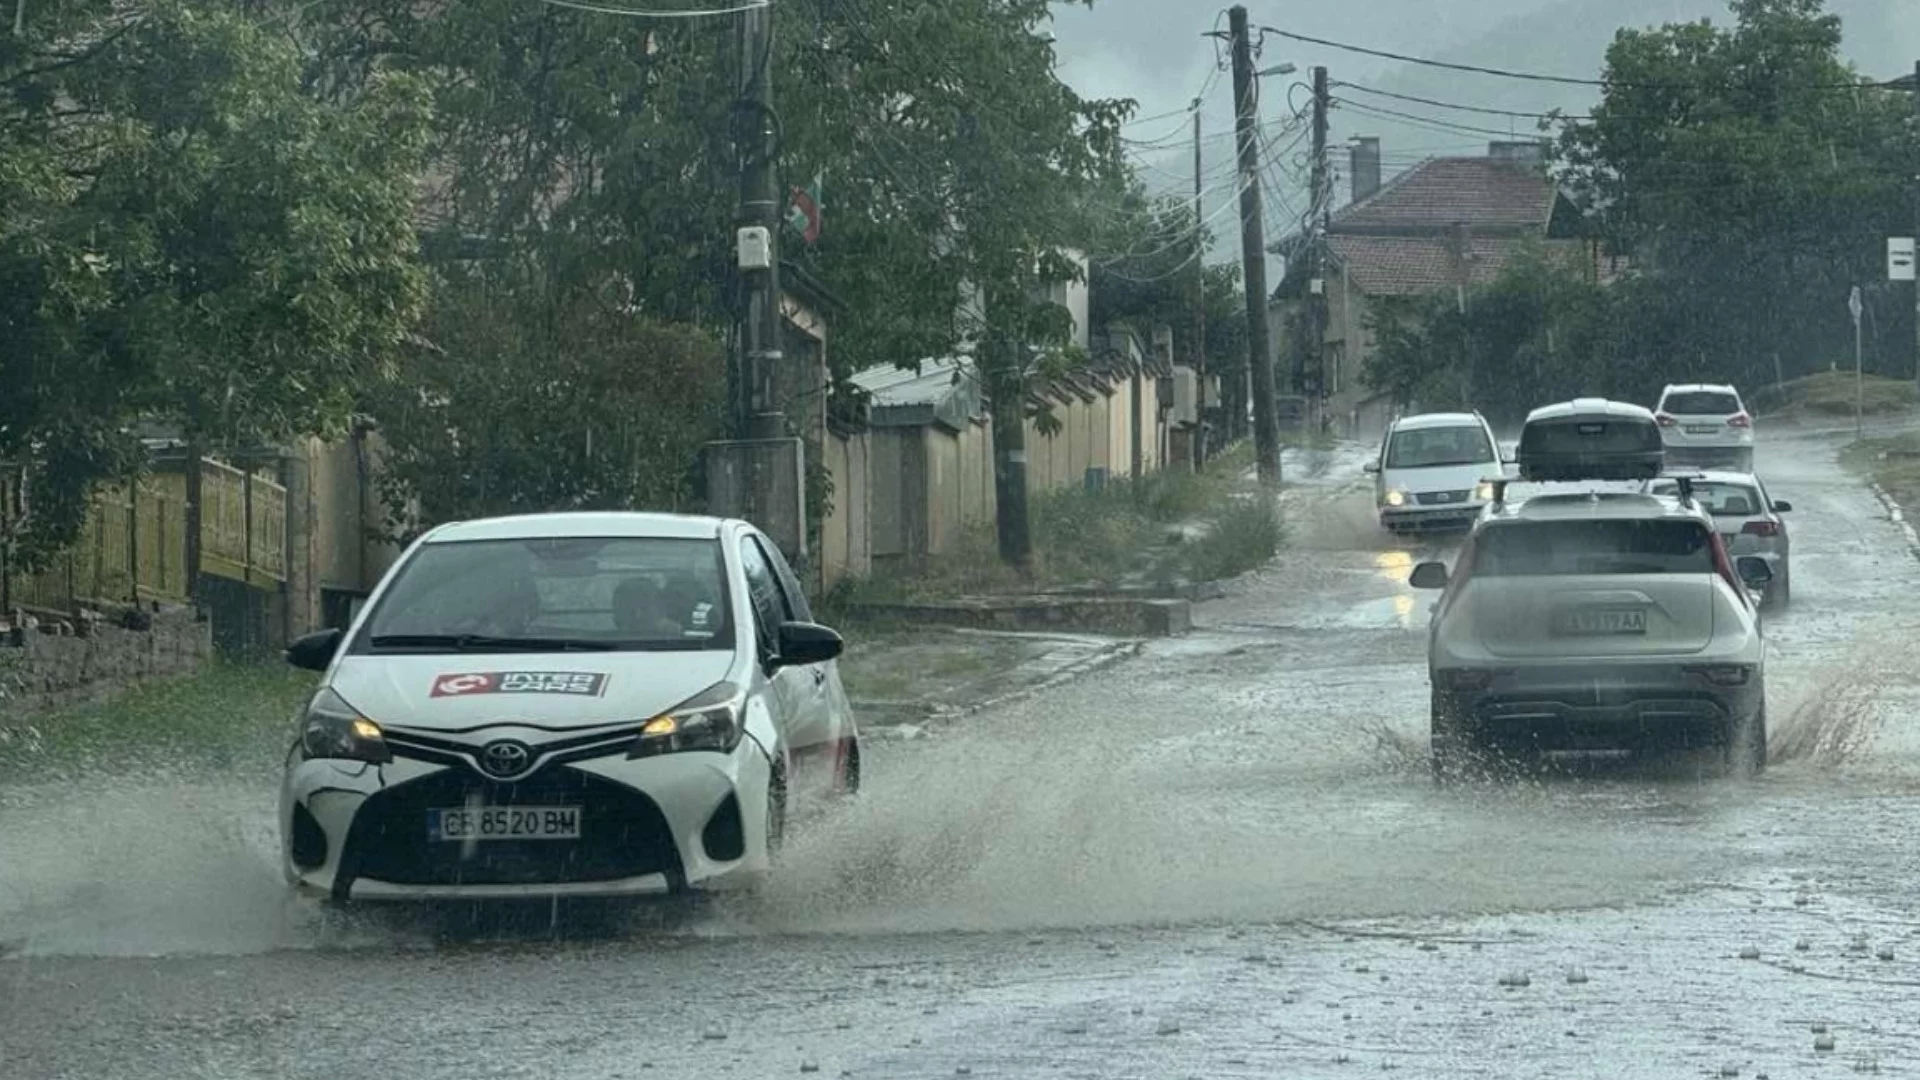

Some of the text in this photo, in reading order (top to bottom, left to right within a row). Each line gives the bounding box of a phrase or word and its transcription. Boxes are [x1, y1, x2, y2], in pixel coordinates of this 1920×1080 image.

[500, 672, 596, 683] INTER
[499, 682, 590, 693] CARS
[481, 811, 539, 835] 8520
[544, 811, 576, 835] BM
